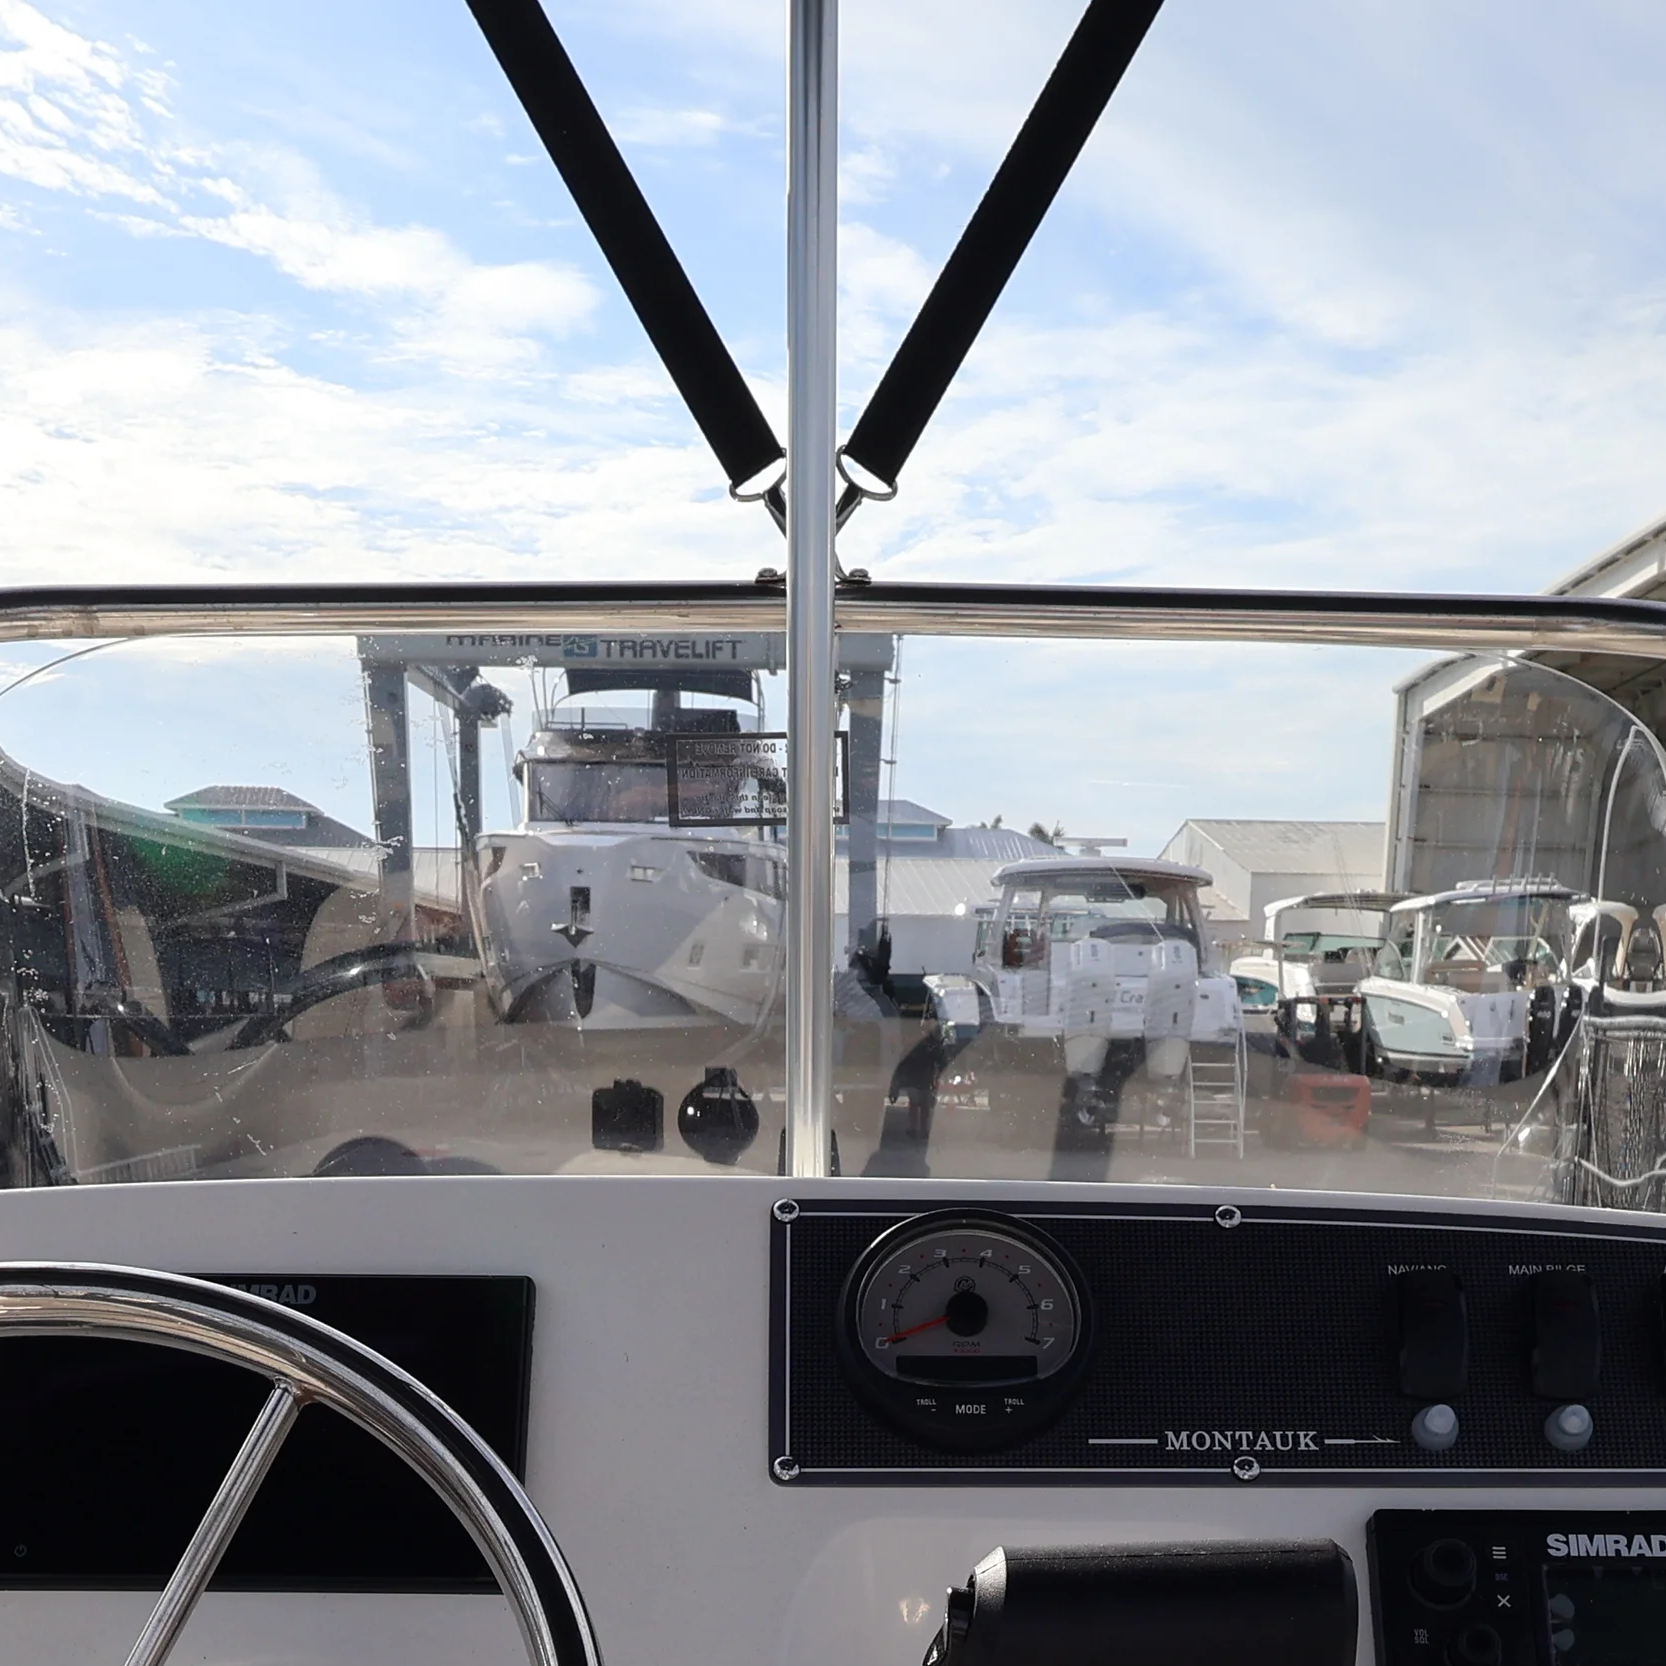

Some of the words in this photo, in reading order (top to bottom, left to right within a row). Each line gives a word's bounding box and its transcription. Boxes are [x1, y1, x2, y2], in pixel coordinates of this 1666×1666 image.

[600, 639, 743, 659] TRAVELIFT
[934, 1249, 947, 1258] 3
[979, 1249, 993, 1258] 4
[898, 1265, 911, 1274] 2
[1018, 1265, 1031, 1274] 5
[880, 1299, 887, 1310] 1
[1040, 1299, 1054, 1310] 6
[1042, 1337, 1055, 1349] 7
[955, 1405, 987, 1415] MODE
[1164, 1430, 1320, 1452] MONTAUK
